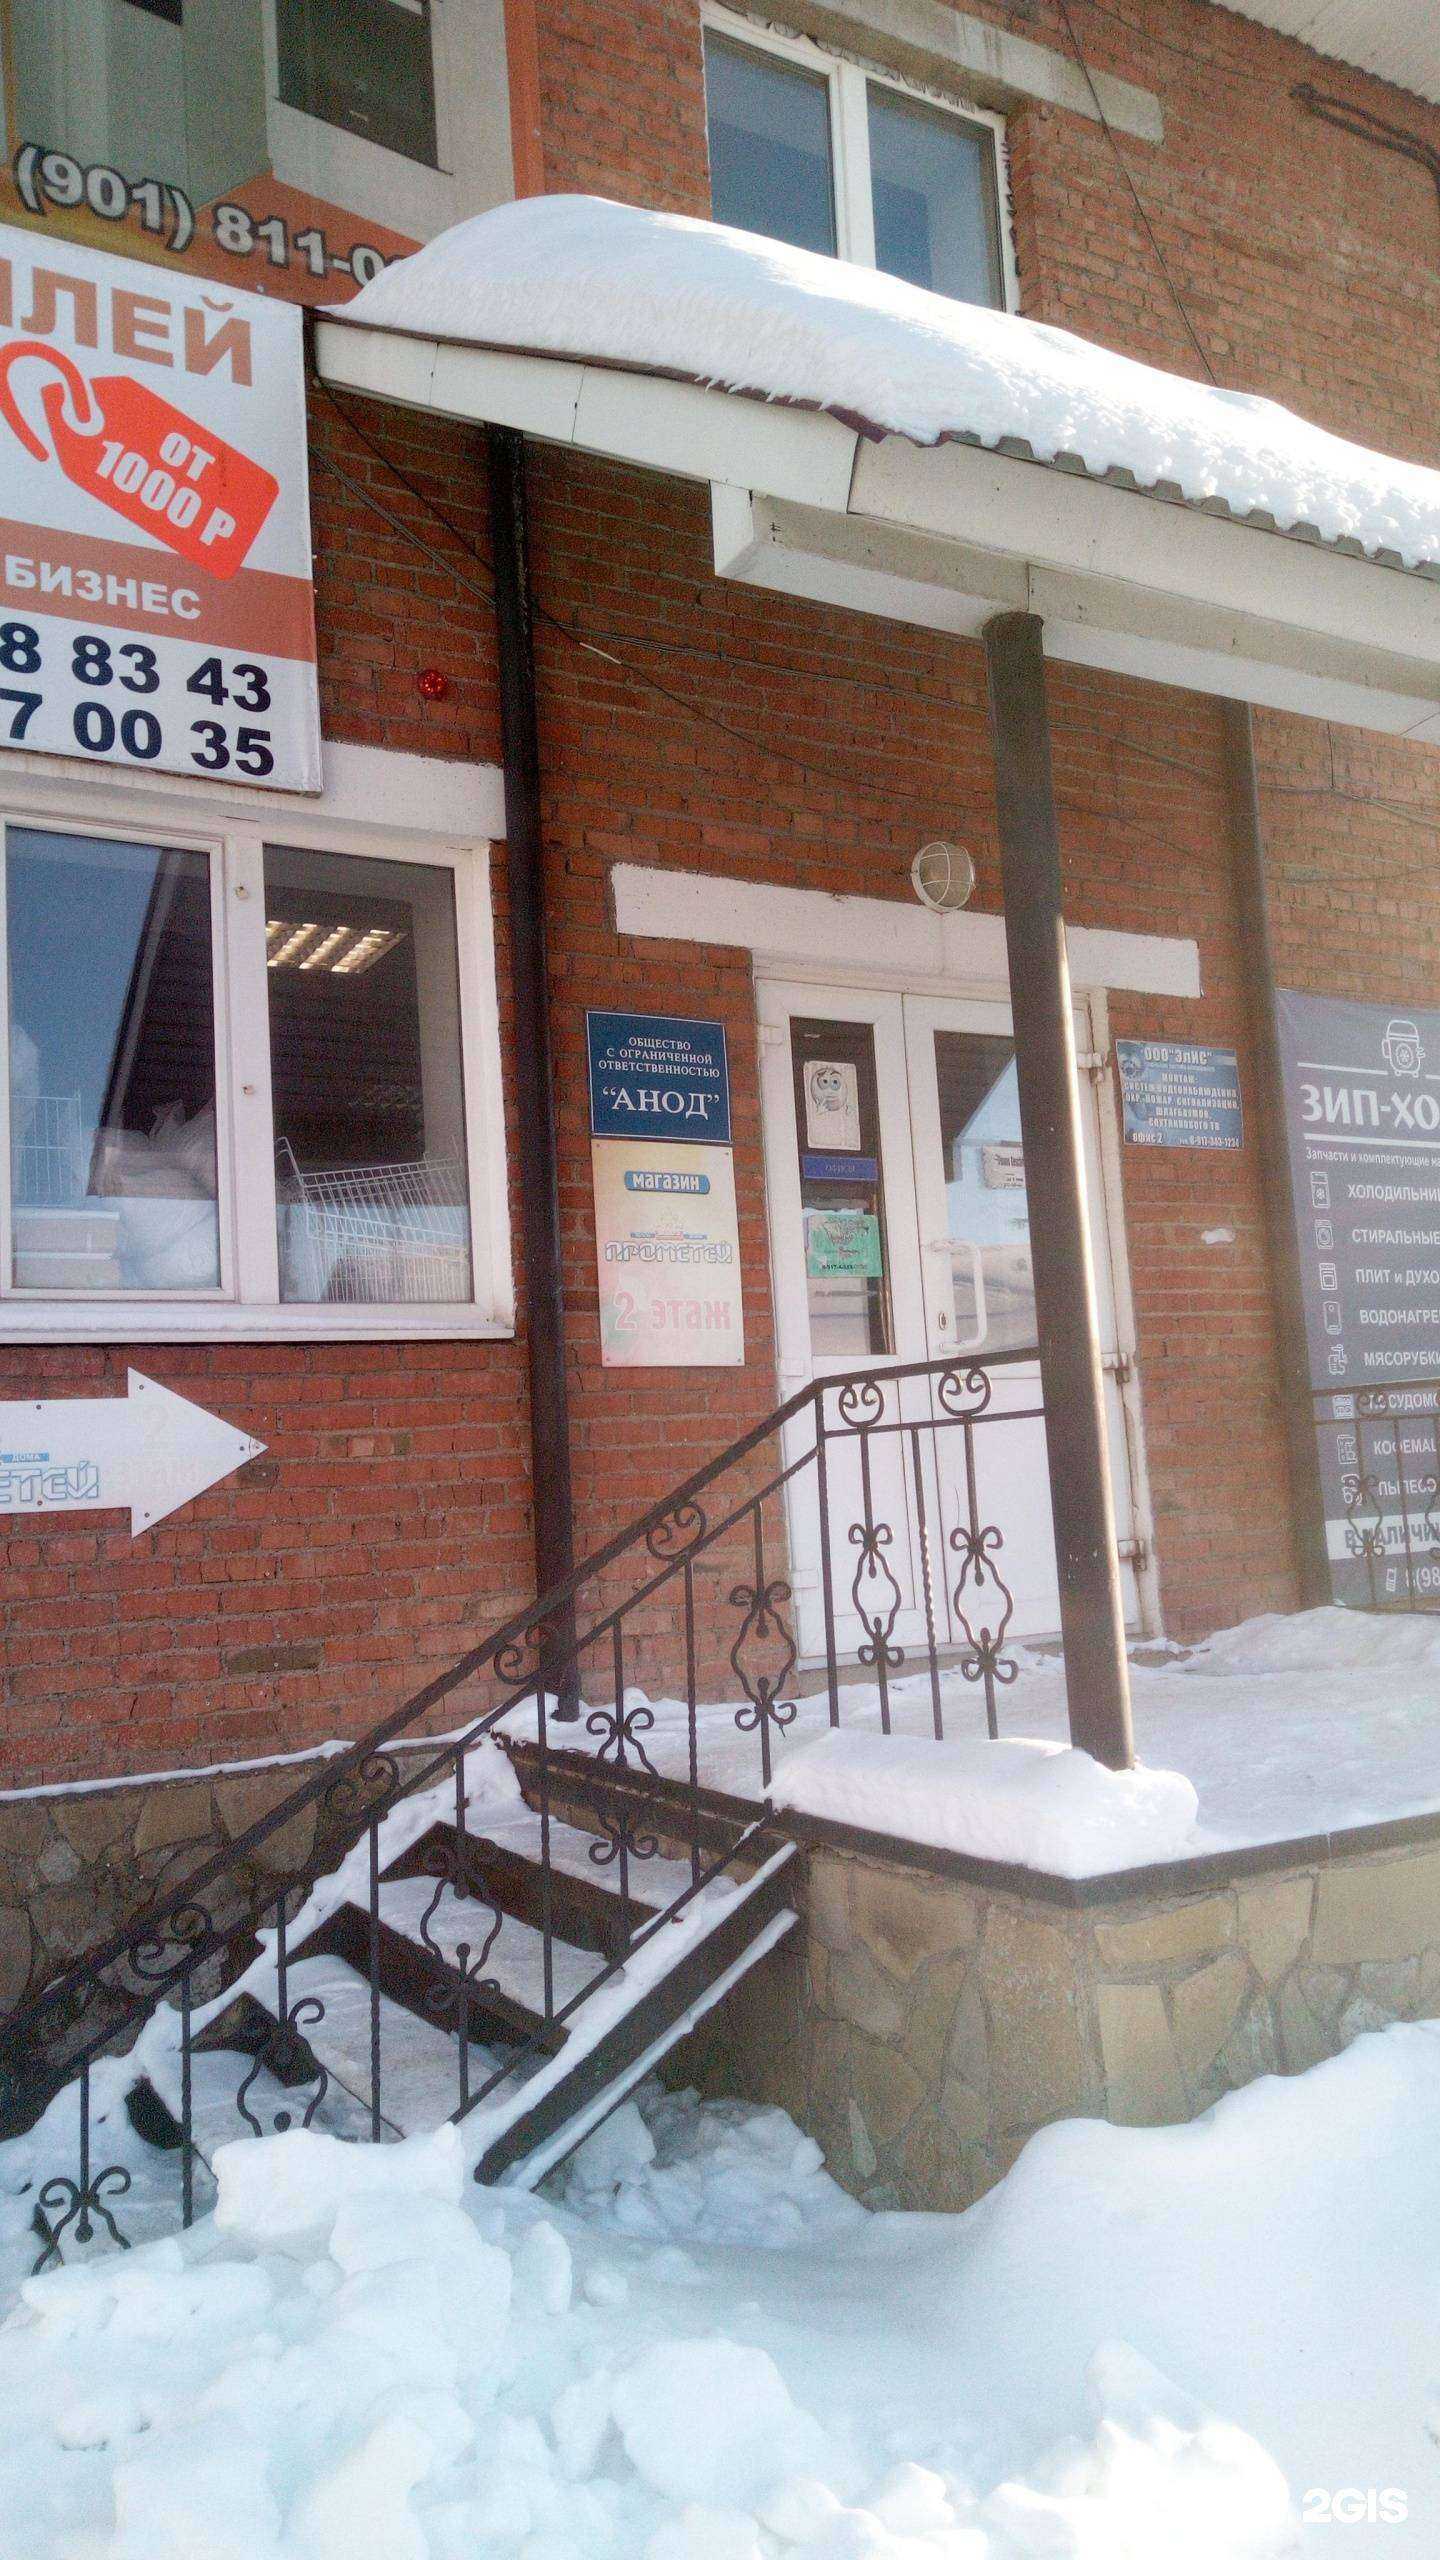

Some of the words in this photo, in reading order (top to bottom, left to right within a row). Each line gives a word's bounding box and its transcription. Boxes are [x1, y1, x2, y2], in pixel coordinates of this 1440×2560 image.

[13, 141, 197, 252] (901)
[212, 202, 404, 288] 811-0
[159, 432, 216, 481] ОТ
[95, 440, 201, 528] 1000
[199, 507, 237, 546] Р
[5, 554, 201, 620] БИЗНЕС
[0, 622, 42, 674] 8
[71, 635, 160, 694] 83
[186, 657, 272, 713] 43
[0, 688, 43, 741] 7
[73, 701, 162, 760] 00
[190, 719, 274, 776] 35
[607, 1048, 615, 1057] С
[619, 1048, 713, 1065] ОГРАНИЧЕННОЙ
[628, 1036, 691, 1050] ОБЩЕСТВО
[598, 1060, 720, 1078] ОТВЕТСТВЕННОСТЬЮ
[1306, 1147, 1349, 1162] Запчасти
[1358, 1154, 1430, 1168] комплектующие
[1347, 1184, 1440, 1202] ХОЛОДИЛЬНИ
[1356, 1269, 1391, 1284] ПЛИТ
[614, 1291, 638, 1331] 2
[1360, 1309, 1440, 1326] ВОДОНАГРЕ
